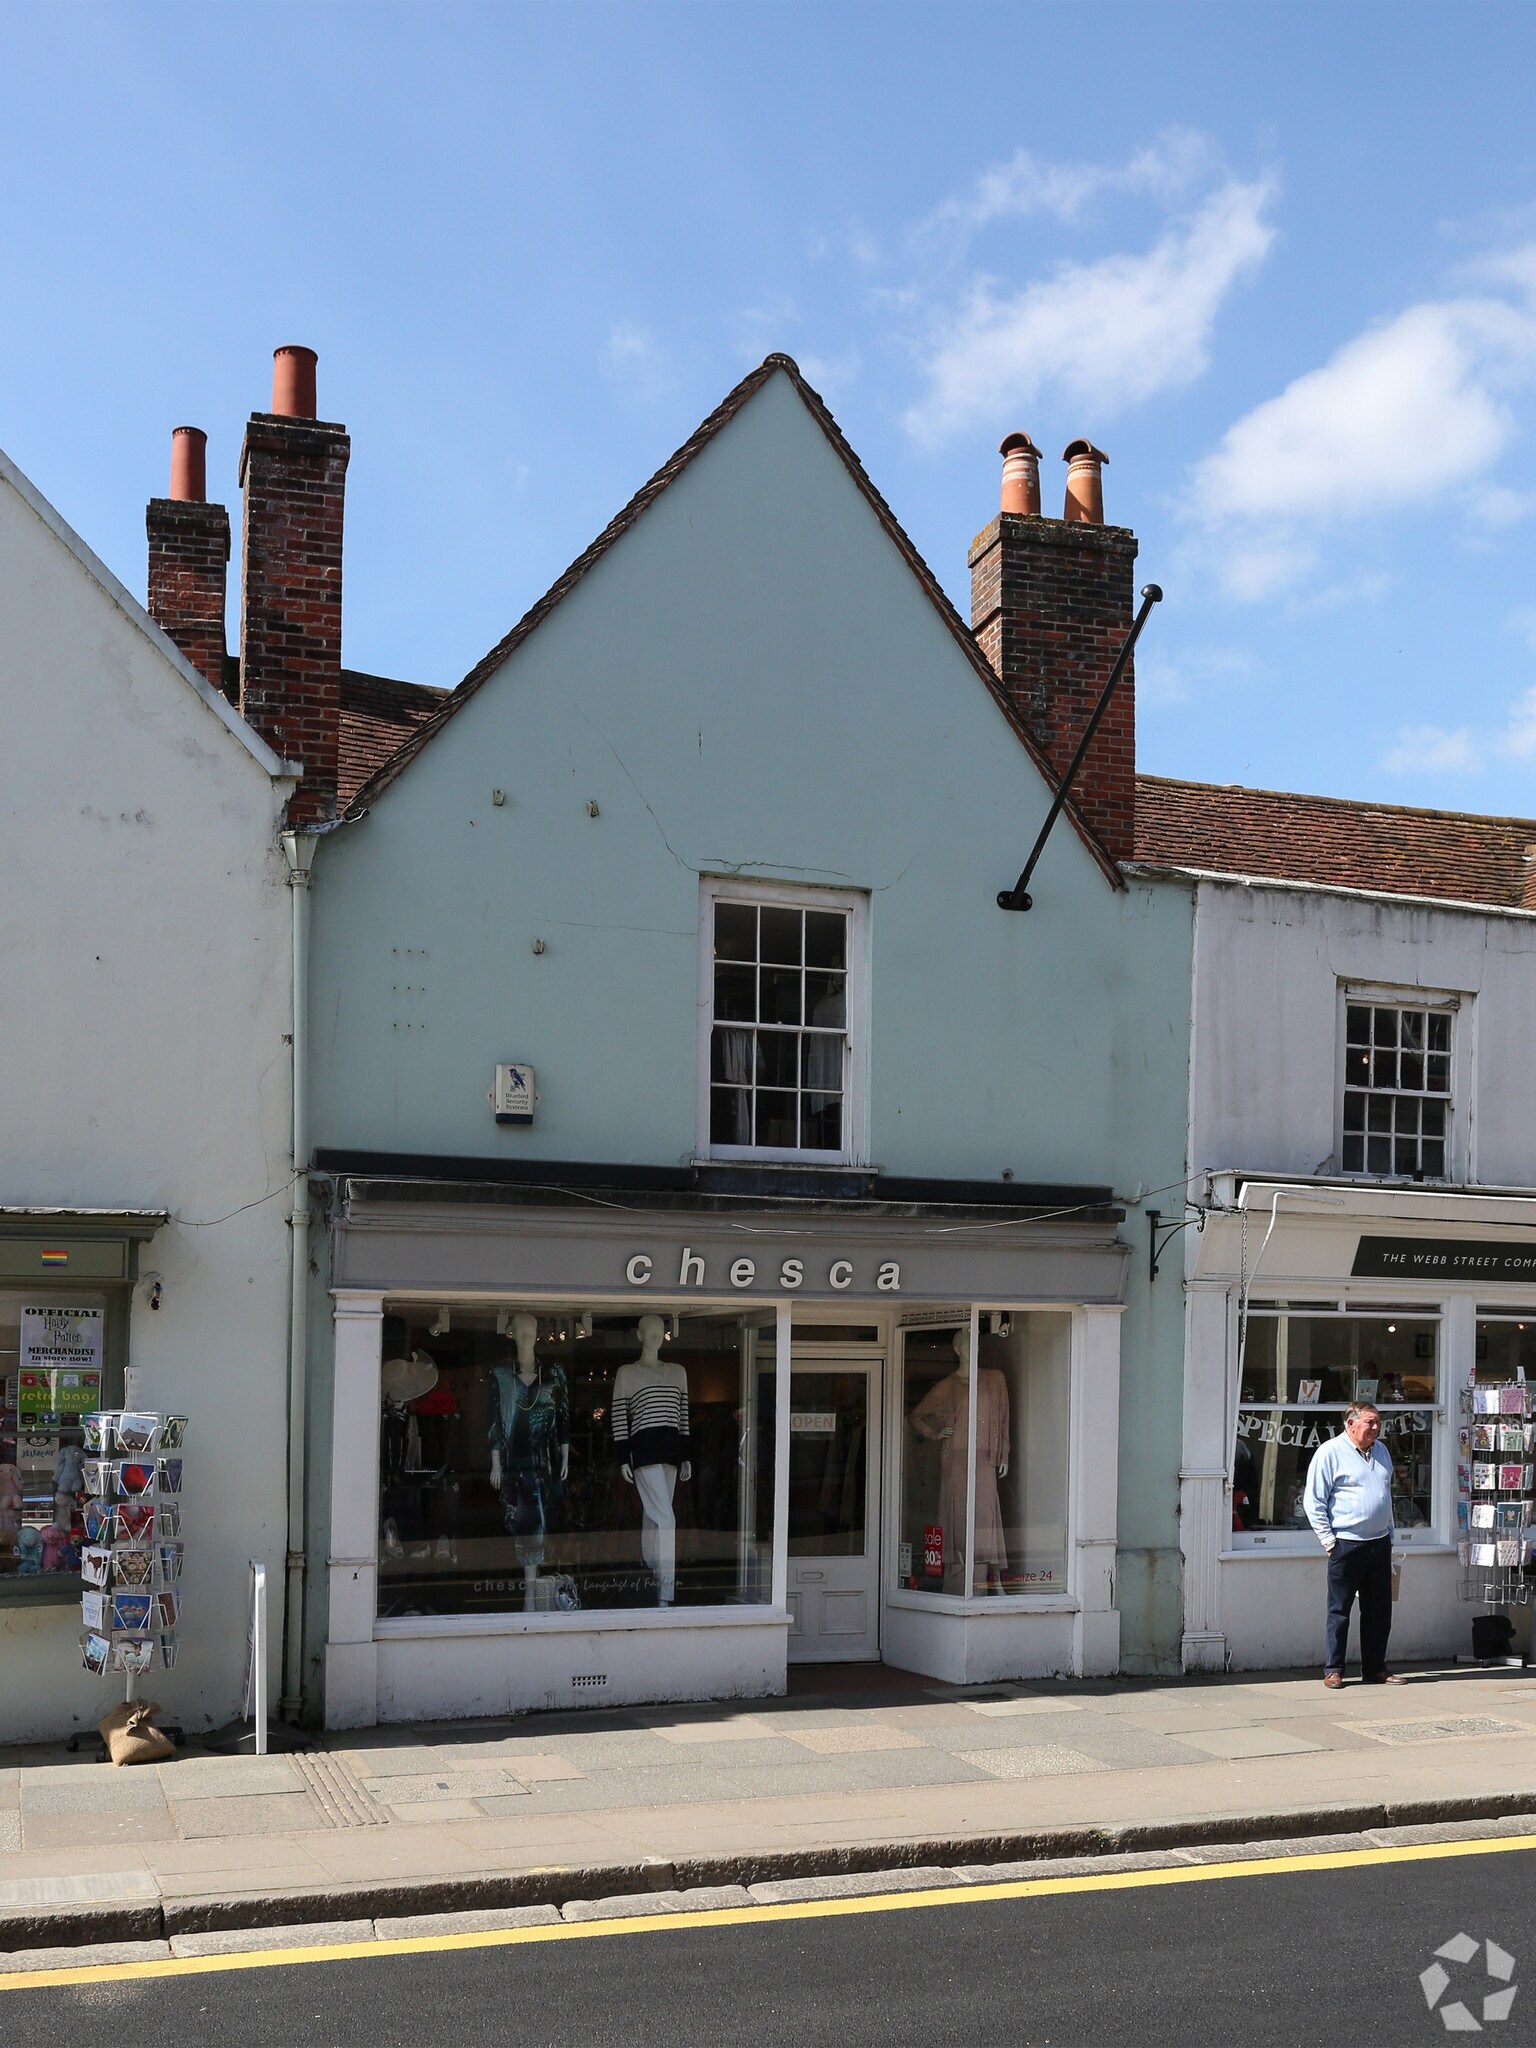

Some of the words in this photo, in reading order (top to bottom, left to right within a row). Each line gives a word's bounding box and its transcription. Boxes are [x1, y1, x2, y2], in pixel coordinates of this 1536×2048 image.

[1382, 1253, 1407, 1263] THE
[1413, 1254, 1447, 1265] WEBB
[1453, 1256, 1499, 1267] STREET
[626, 1247, 900, 1290] chesca
[25, 1307, 101, 1318] OFFICIAL
[43, 1316, 69, 1331] Harry
[54, 1329, 82, 1346] Potter
[28, 1346, 96, 1356] MERCHANDISE
[62, 1391, 97, 1404] bags
[792, 1415, 833, 1429] OPEN
[21, 1449, 56, 1458] JELLYCAT
[924, 1527, 942, 1545] sale
[1039, 1570, 1053, 1581] 24
[584, 1579, 627, 1592] Language
[630, 1577, 641, 1591] of
